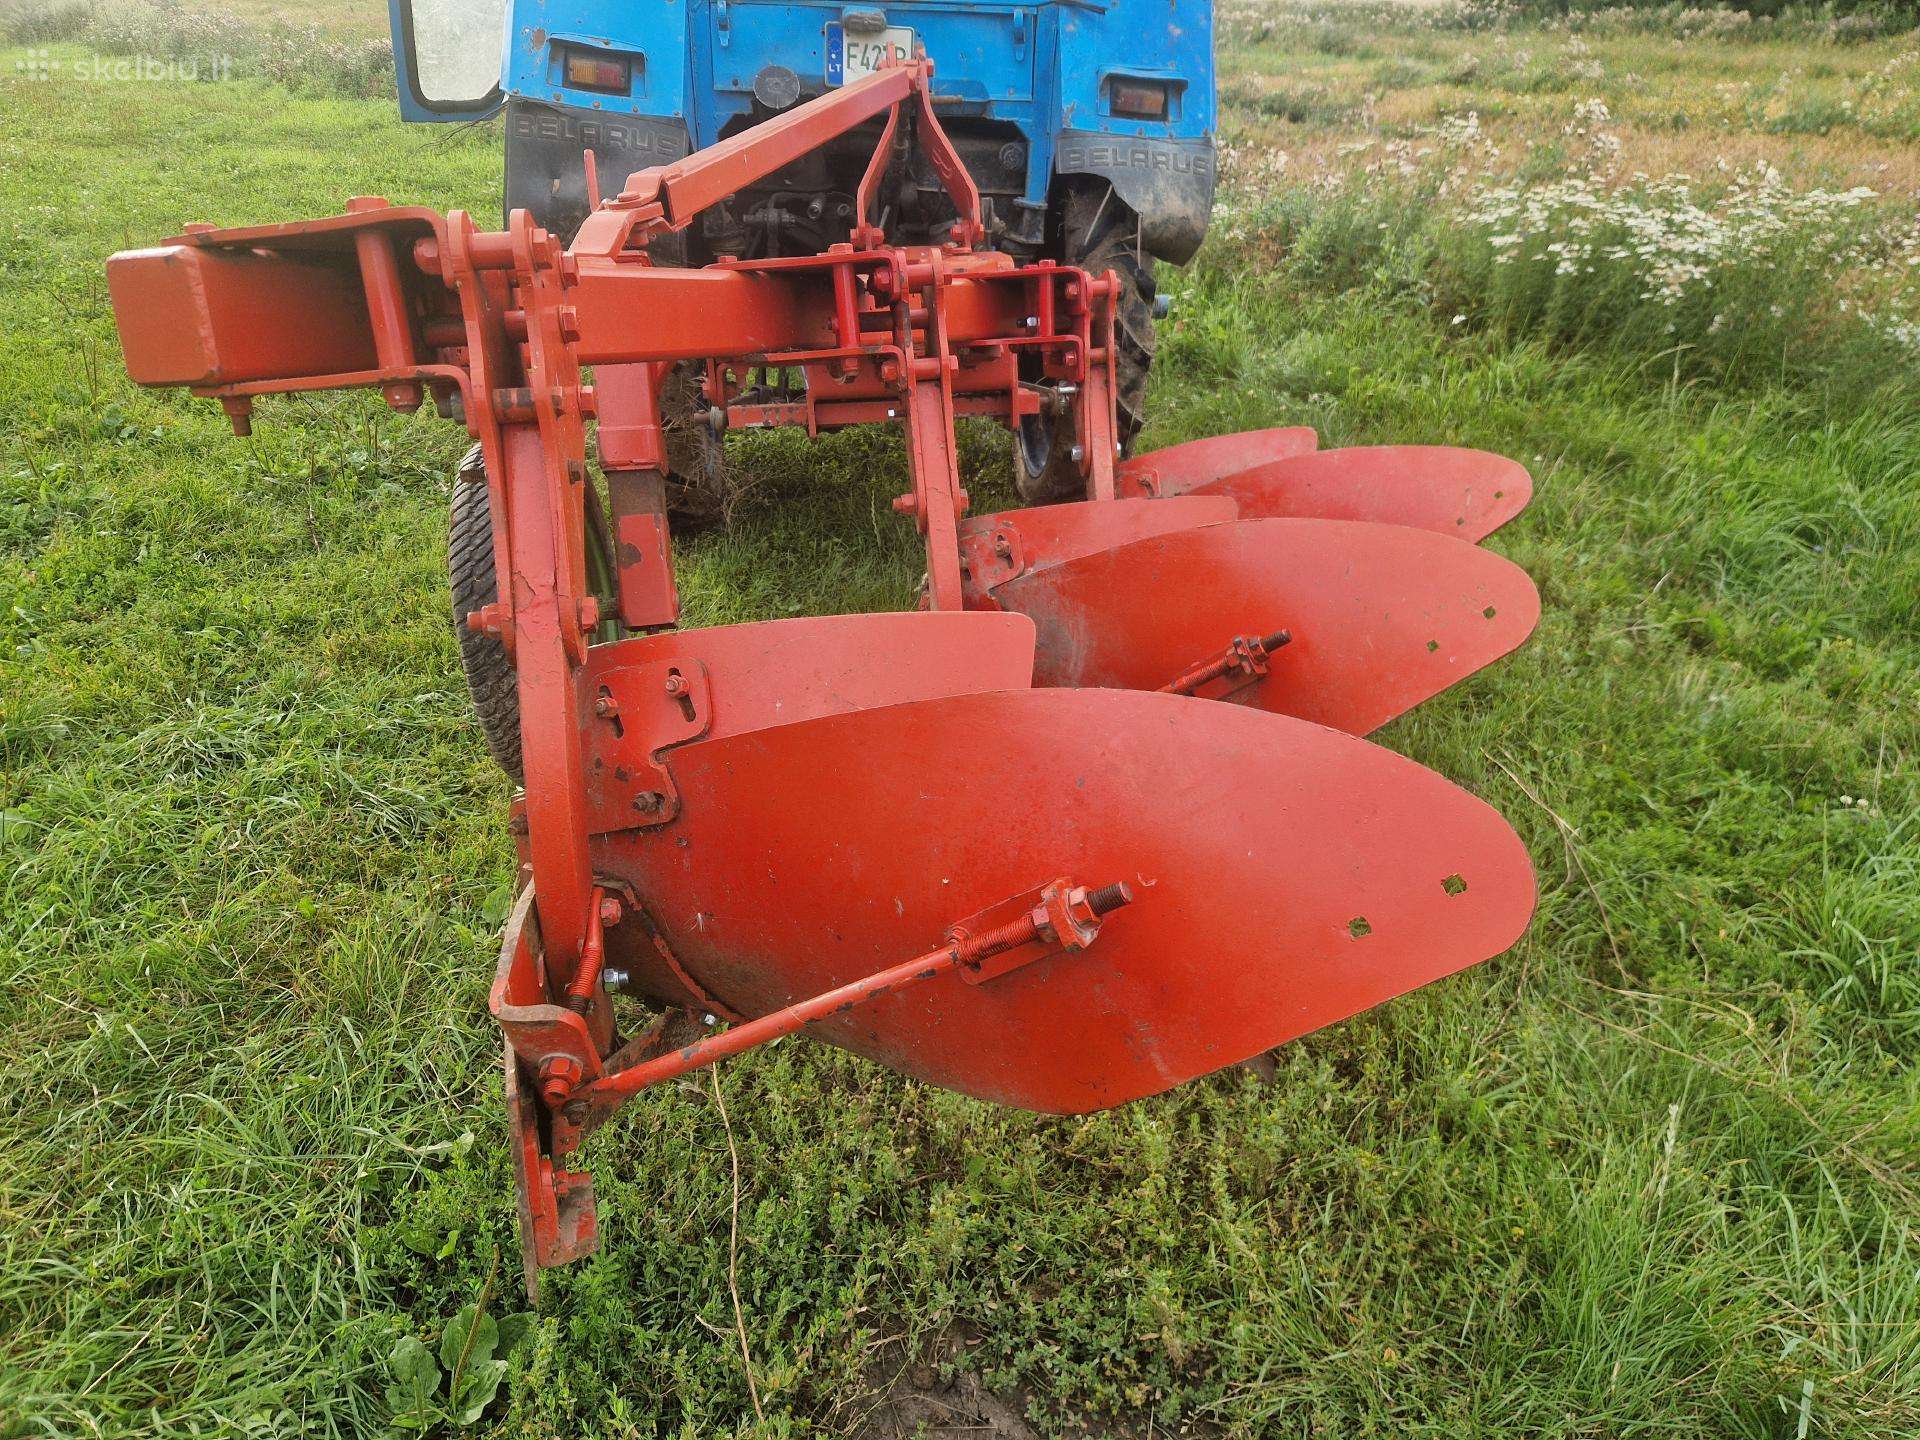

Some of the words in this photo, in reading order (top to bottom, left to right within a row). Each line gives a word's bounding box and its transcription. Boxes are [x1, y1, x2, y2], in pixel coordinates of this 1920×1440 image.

[828, 63, 841, 72] LT
[514, 114, 681, 156] BELARUS
[1065, 147, 1211, 177] BELARUS
